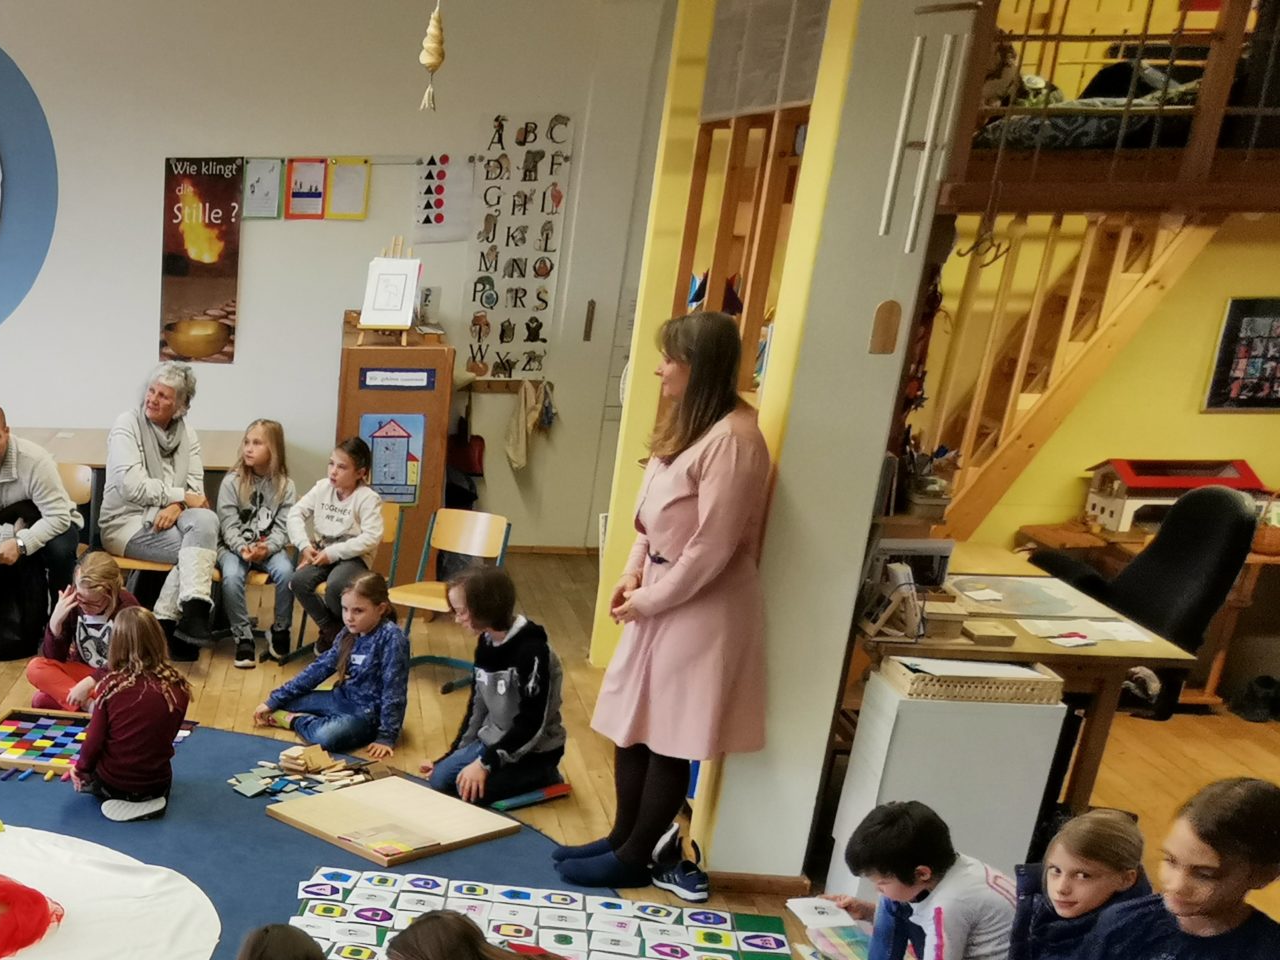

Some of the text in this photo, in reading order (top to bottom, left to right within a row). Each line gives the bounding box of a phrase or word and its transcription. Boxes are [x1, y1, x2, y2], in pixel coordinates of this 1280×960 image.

[487, 119, 569, 151] A B C
[171, 161, 238, 178] Wie klingt
[485, 159, 503, 181] D
[549, 153, 563, 175] F
[172, 202, 239, 224] Stille ?
[483, 185, 547, 216] G H I
[486, 221, 557, 253] J K L
[478, 251, 554, 279] M N O
[472, 281, 549, 311] P Q R S
[469, 344, 490, 363] W
